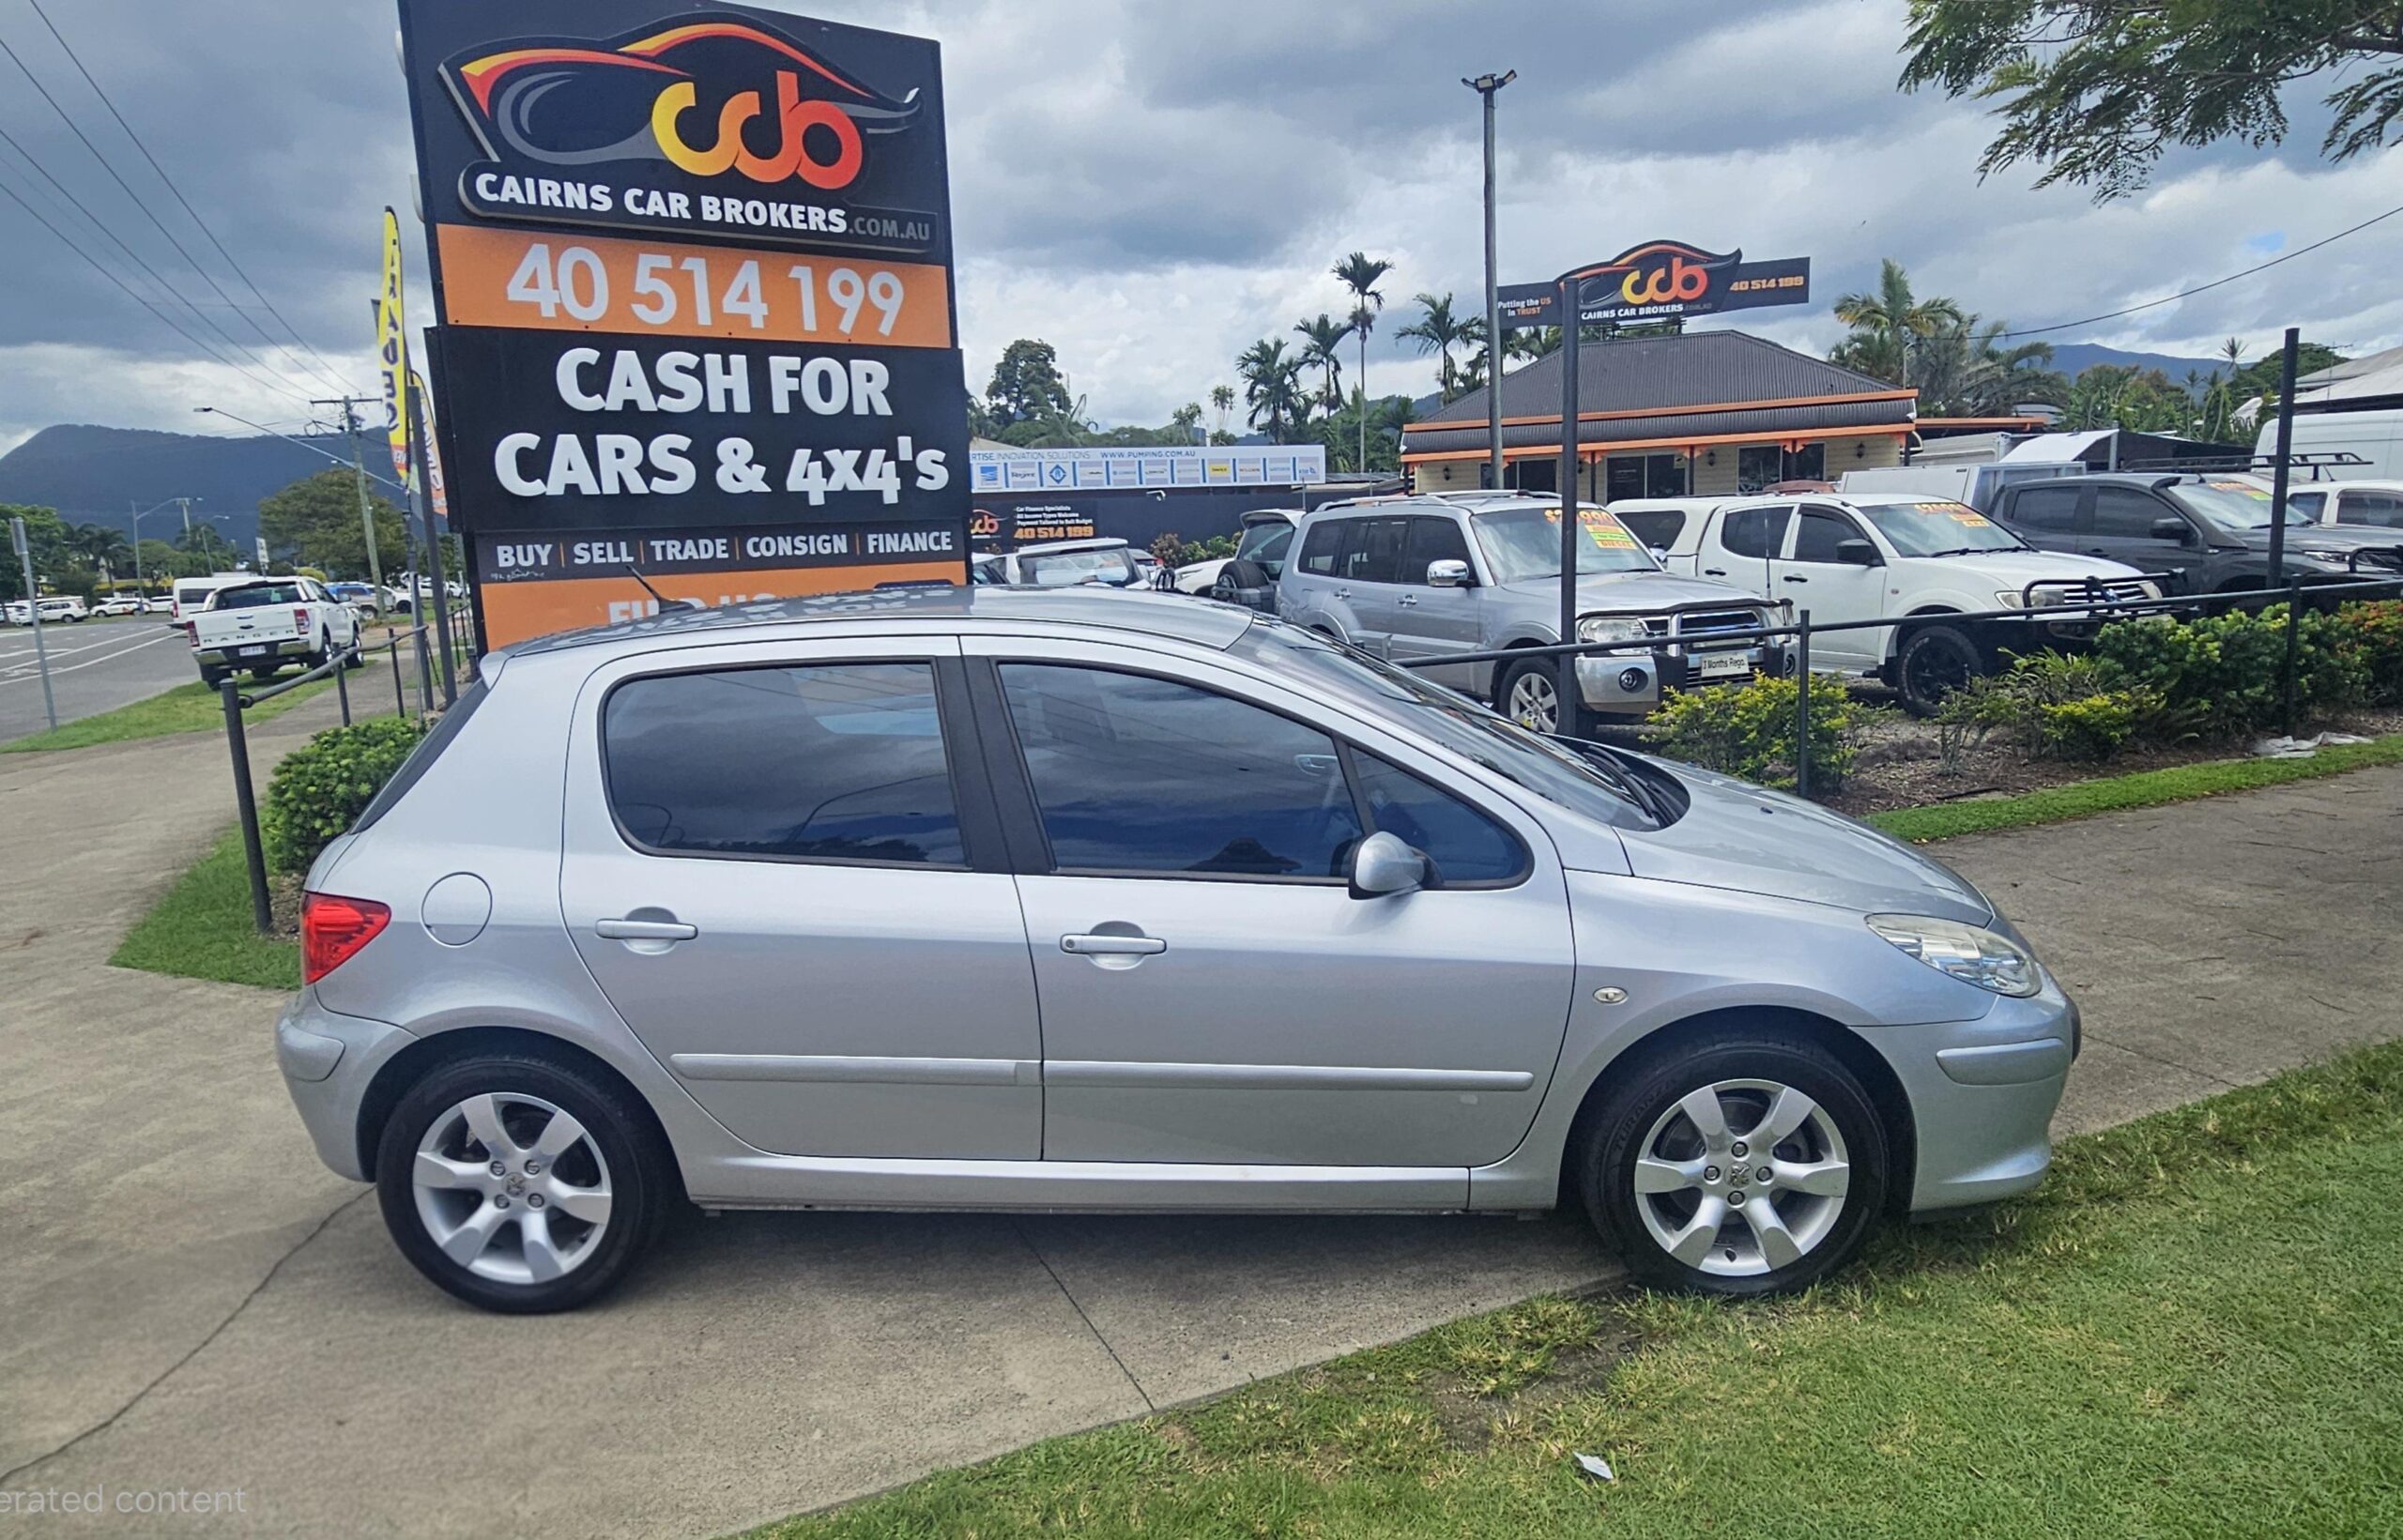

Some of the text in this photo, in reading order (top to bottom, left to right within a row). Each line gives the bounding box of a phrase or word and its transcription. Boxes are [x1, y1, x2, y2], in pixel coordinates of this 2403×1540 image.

[476, 173, 613, 212] CAIRNS
[624, 189, 692, 219] CAR
[507, 243, 904, 336] 40 514 199
[1730, 281, 1749, 292] 40
[1751, 278, 1776, 290] 514
[1498, 299, 1526, 310] Putting
[1526, 297, 1539, 307] the
[1517, 306, 1541, 316] TRUST
[1581, 309, 1615, 320] CAIRNS
[1617, 307, 1636, 317] CAR
[556, 347, 893, 416] CASH FOR
[972, 450, 1196, 461] RTISE INNOVATION SOLUTIONS WWW.PUMPING.COM.AU
[495, 433, 696, 496] CARS
[715, 437, 772, 494] &
[1014, 526, 1094, 539] 40 514 199
[497, 531, 953, 568] BUY SELL TRADE CONSIGN FINANCE
